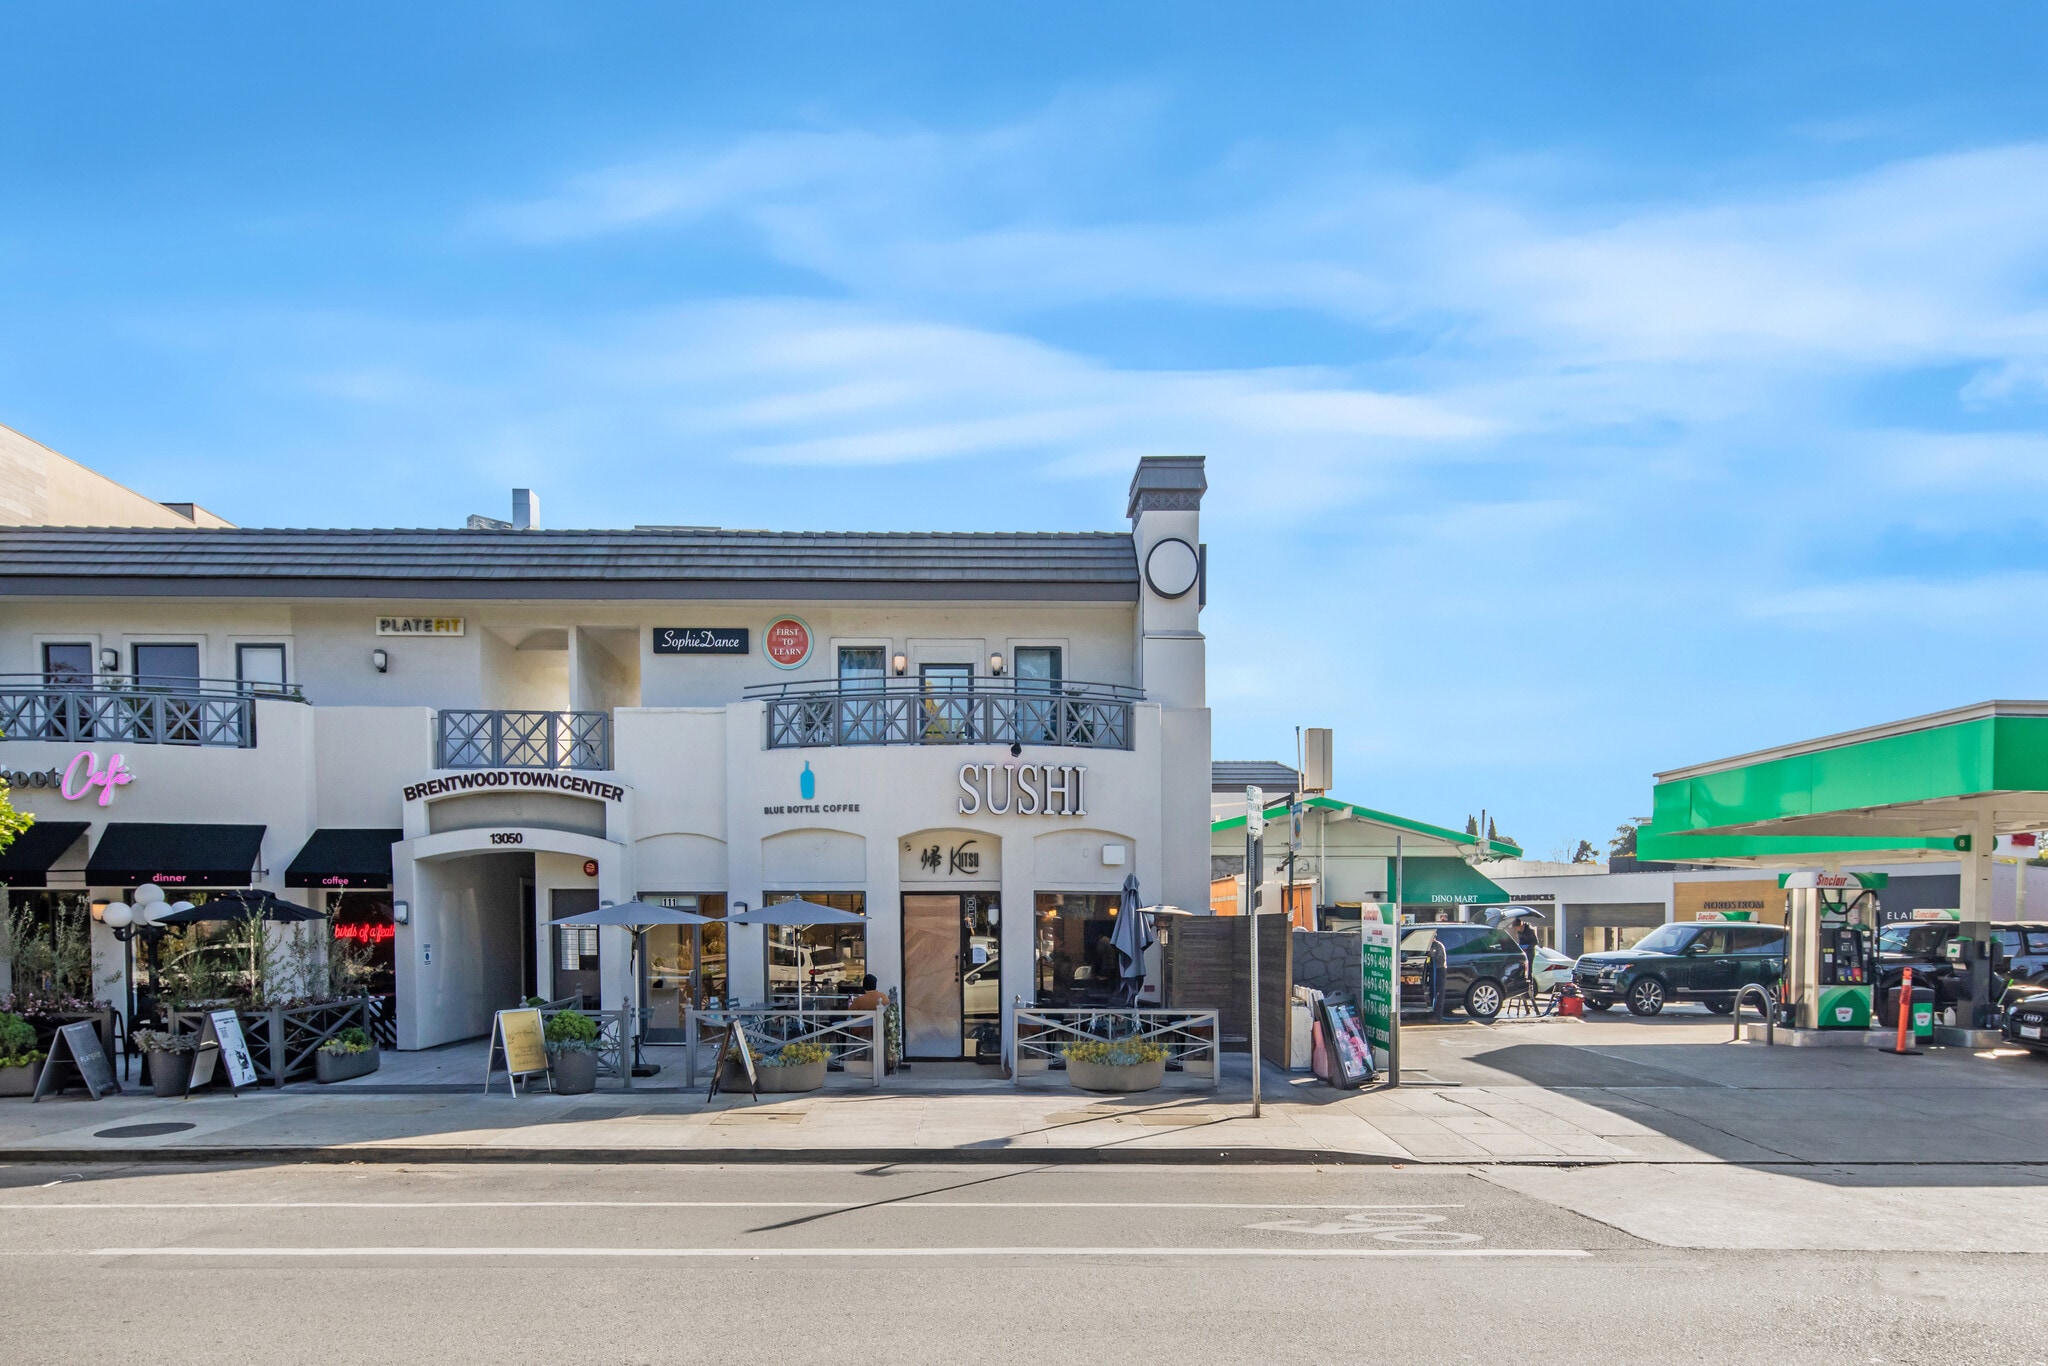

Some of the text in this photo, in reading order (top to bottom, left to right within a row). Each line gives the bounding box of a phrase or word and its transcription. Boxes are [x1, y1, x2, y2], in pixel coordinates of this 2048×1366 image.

[380, 618, 461, 632] PLATEFIT
[776, 628, 799, 636] FIRST
[661, 630, 740, 651] SophieDance
[783, 638, 794, 646] TO
[774, 647, 801, 656] LEARN
[403, 771, 625, 802] BRENTWOOD TOWN CENTER
[958, 763, 1088, 816] SUSHI
[764, 803, 860, 815] BLUE BOTTLE COFFEE
[489, 832, 523, 844] 13050
[1959, 839, 1966, 847] 8
[152, 873, 187, 882] dinner
[322, 876, 349, 885] coffee
[1816, 873, 1848, 887] Sinclair
[662, 898, 677, 907] 111
[1431, 895, 1479, 903] DINO MART
[1703, 900, 1765, 909] NORDSTROM
[335, 923, 358, 939] birds
[359, 923, 370, 943] of
